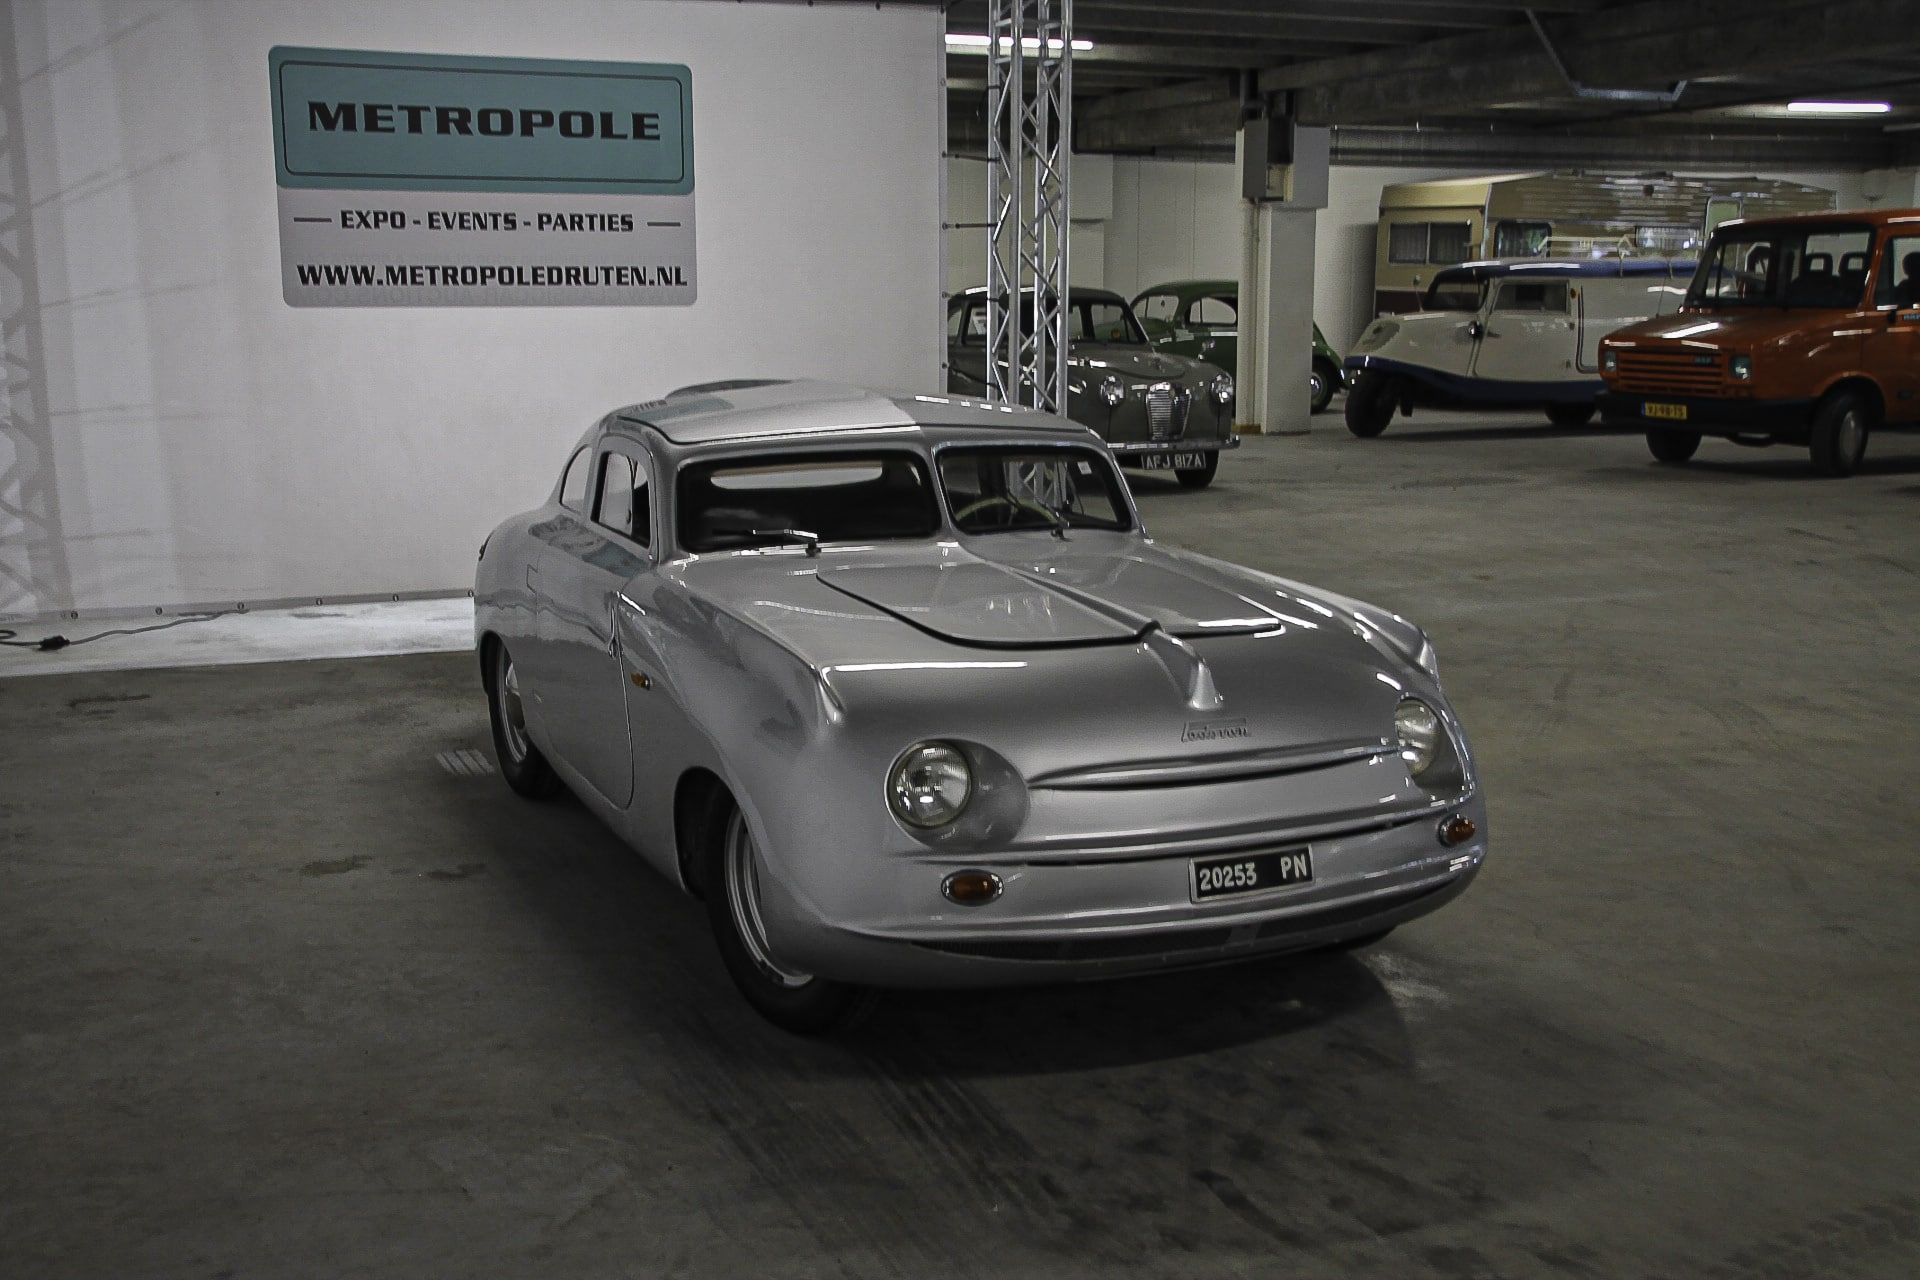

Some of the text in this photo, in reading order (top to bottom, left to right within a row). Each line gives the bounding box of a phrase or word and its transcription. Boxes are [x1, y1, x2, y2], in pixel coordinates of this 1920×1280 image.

[307, 100, 661, 141] METROPOLE
[340, 209, 406, 230] EXPO
[427, 211, 517, 231] EVENTS
[537, 212, 634, 232] PARTIES
[296, 264, 688, 287] WWW.METROPOLEDRUTEN.NL
[1146, 455, 1170, 470] AFJ
[1199, 853, 1307, 891] 20253 PN
